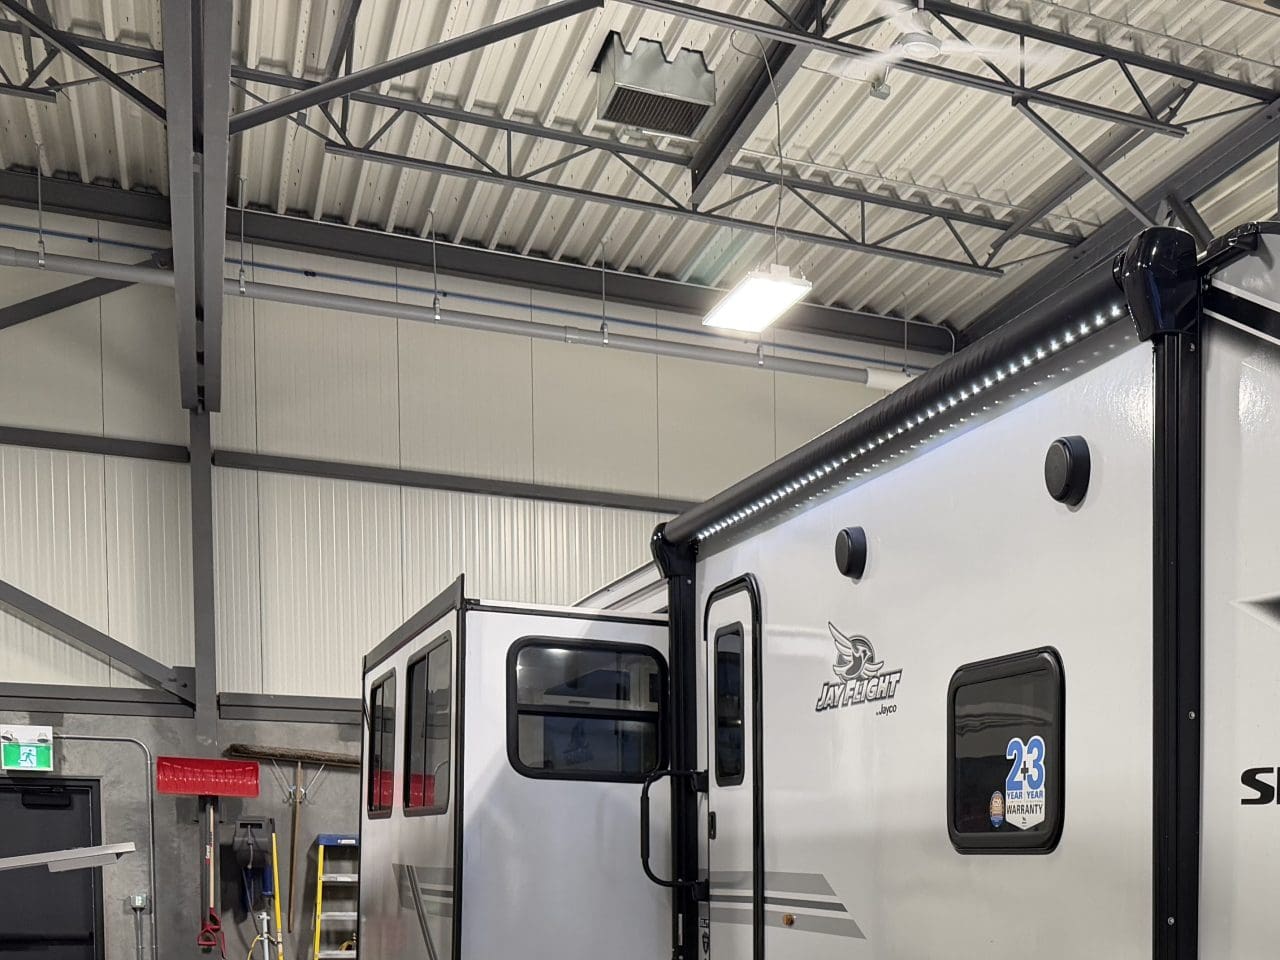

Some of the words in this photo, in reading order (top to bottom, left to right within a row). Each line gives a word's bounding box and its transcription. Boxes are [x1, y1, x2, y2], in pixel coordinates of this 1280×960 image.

[1007, 791, 1023, 800] YEAR
[1027, 791, 1043, 799] YEAR
[1007, 803, 1043, 815] WARRANTY
